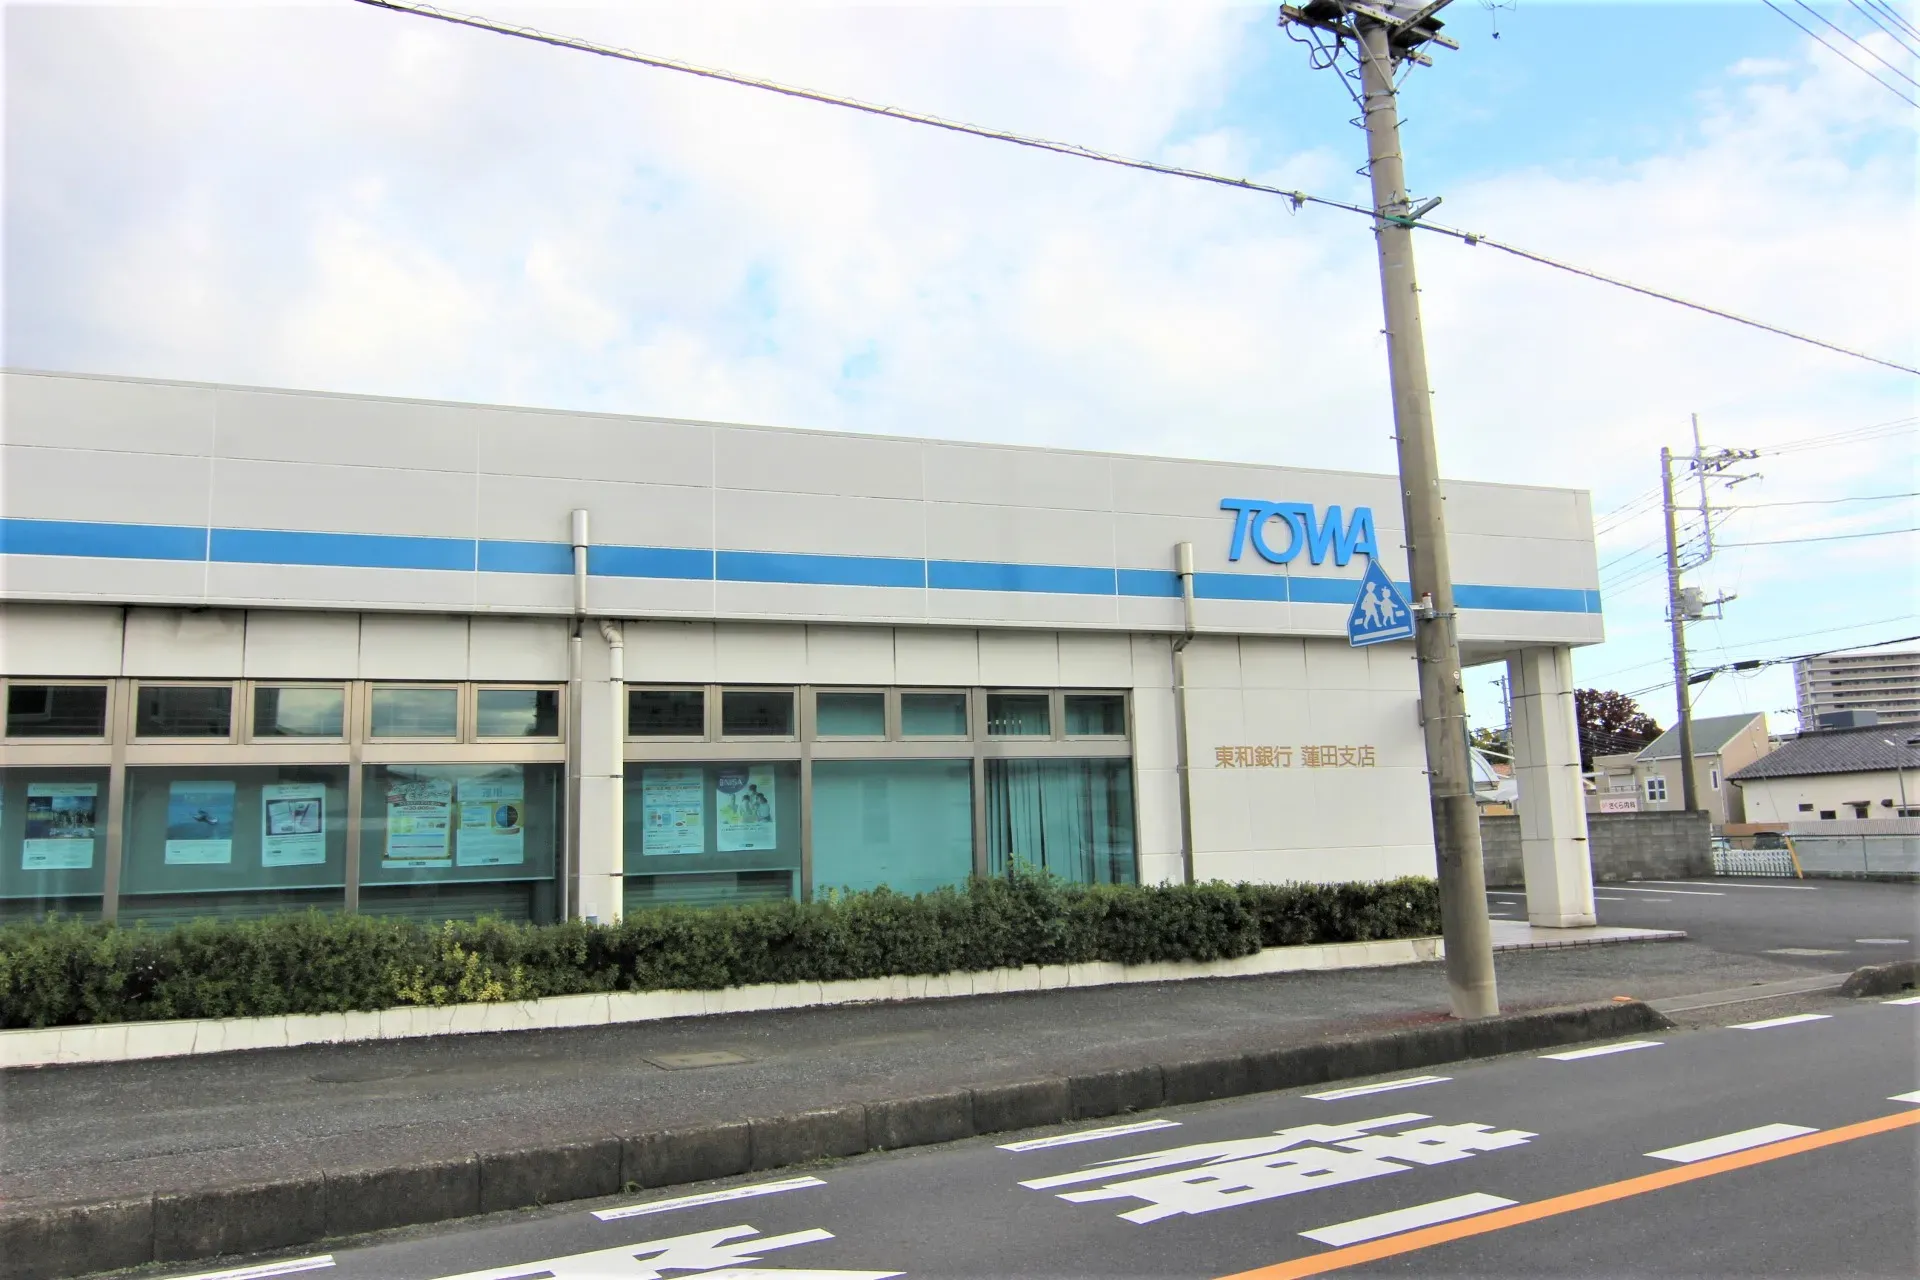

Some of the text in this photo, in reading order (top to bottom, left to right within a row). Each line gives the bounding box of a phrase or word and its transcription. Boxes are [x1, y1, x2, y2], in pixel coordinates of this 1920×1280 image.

[1219, 498, 1378, 566] TOWA
[1216, 745, 1375, 768] 東和銀行 蓮田支店
